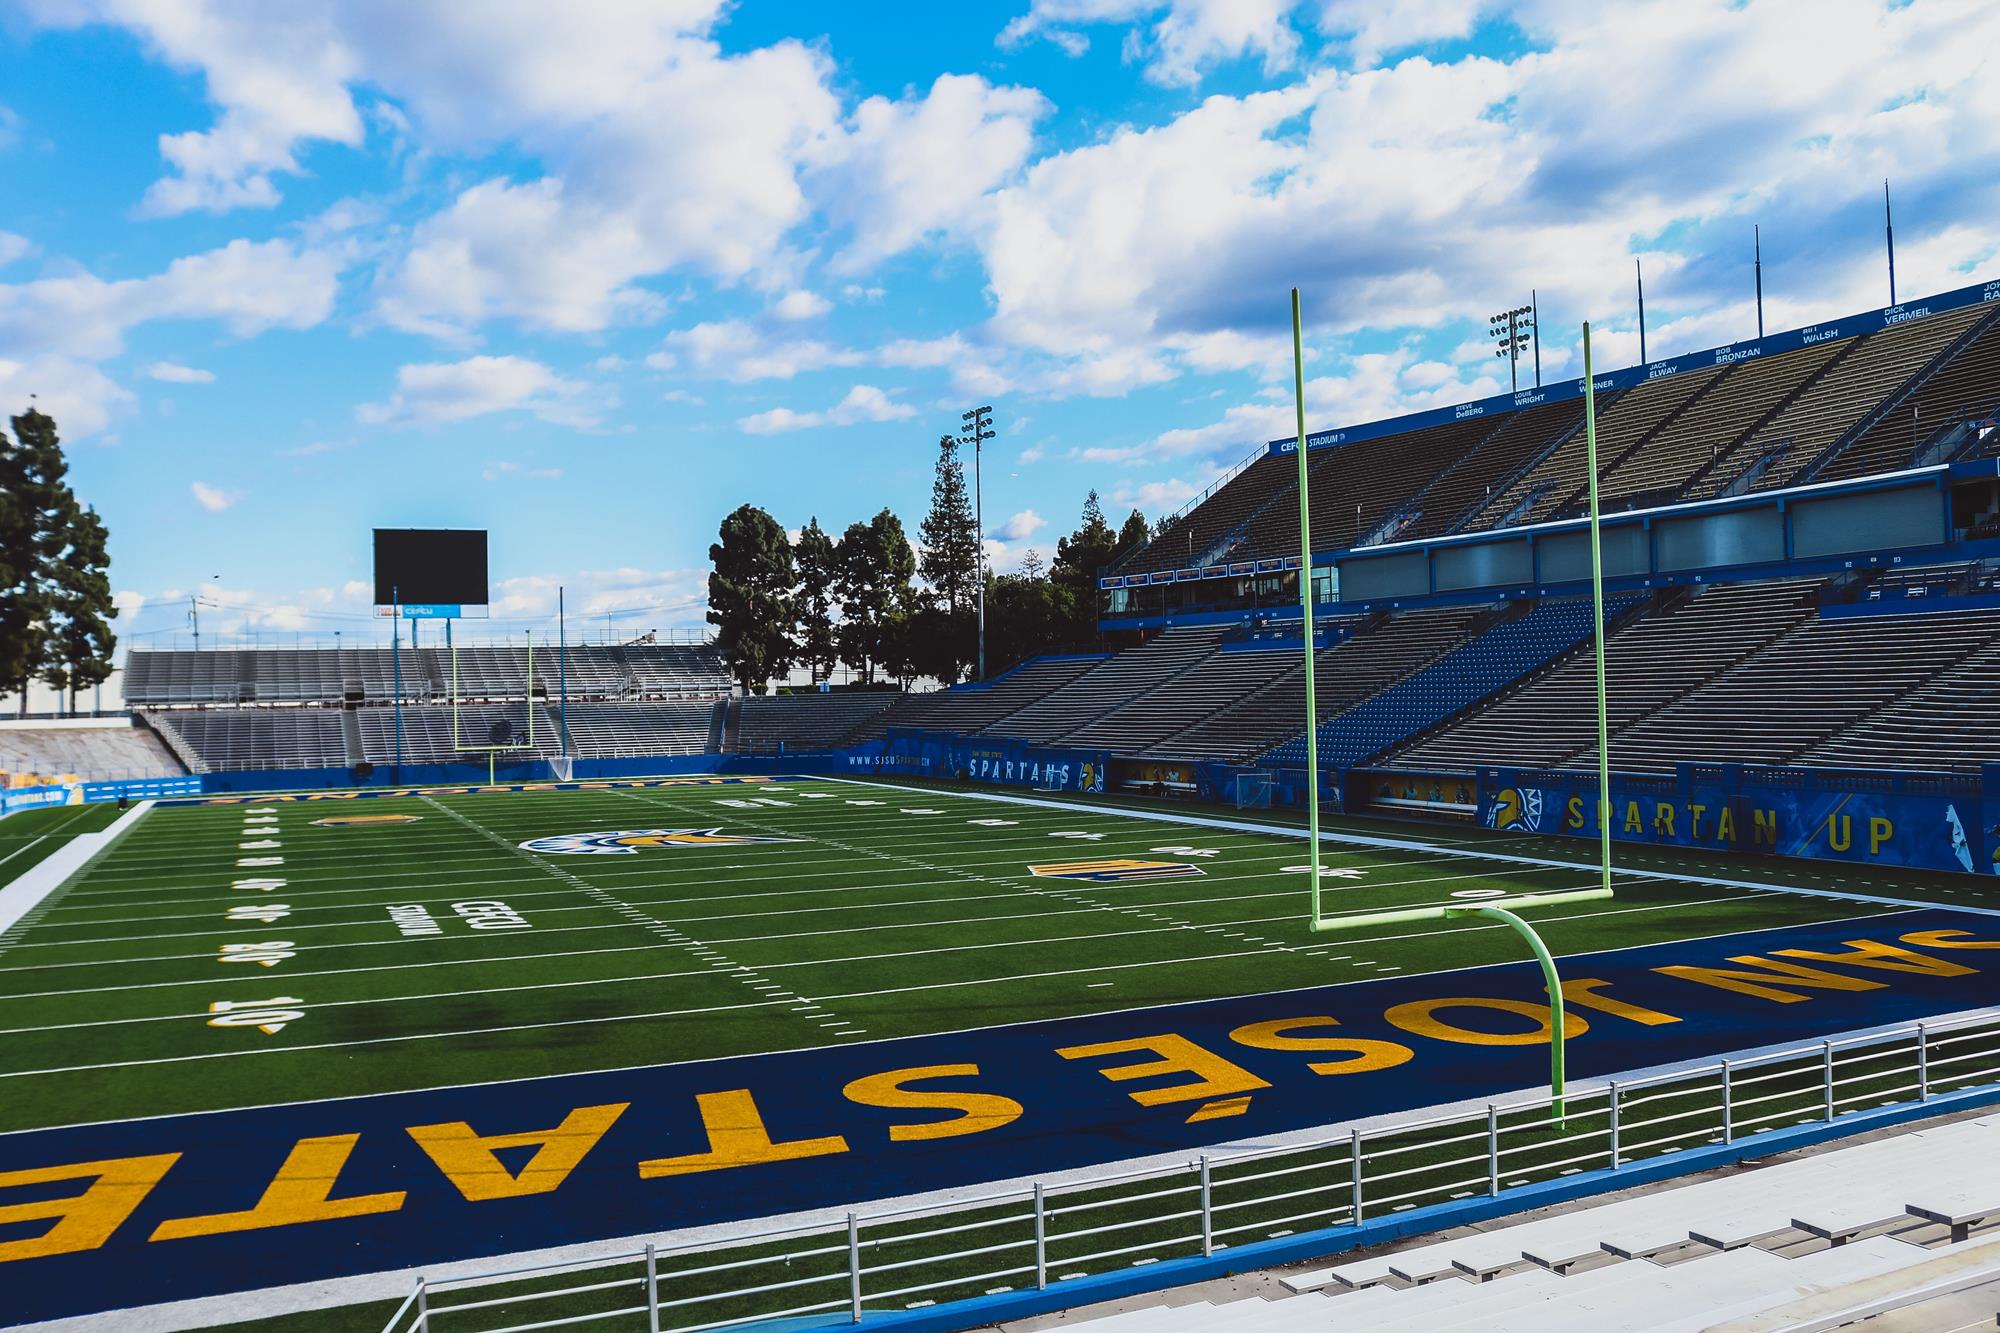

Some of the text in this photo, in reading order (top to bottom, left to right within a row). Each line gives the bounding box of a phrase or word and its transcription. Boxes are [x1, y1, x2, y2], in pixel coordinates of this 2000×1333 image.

[1884, 305, 1904, 316] DICK
[1885, 307, 1931, 324] VERMEIL
[1803, 329, 1838, 344] WALSH
[1715, 347, 1731, 356] BOB
[1715, 347, 1761, 364] BRONZAN
[1649, 366, 1677, 379] ELWAY
[1650, 361, 1667, 371] JACK
[1578, 379, 1614, 393] WRNER
[1514, 391, 1532, 399] LOUIE
[1514, 394, 1545, 406] WRIGHT
[1455, 403, 1472, 412] STEVE
[1455, 407, 1484, 419] DeBERG
[1280, 434, 1338, 452] CEFC STADIUM
[969, 758, 1070, 784] SPARTANS
[1568, 796, 1894, 855] SPARTAN UP
[450, 900, 533, 930] CEFCU
[1649, 929, 2000, 1003] SAN
[207, 995, 306, 1027] 10
[0, 1063, 1024, 1263] STATE
